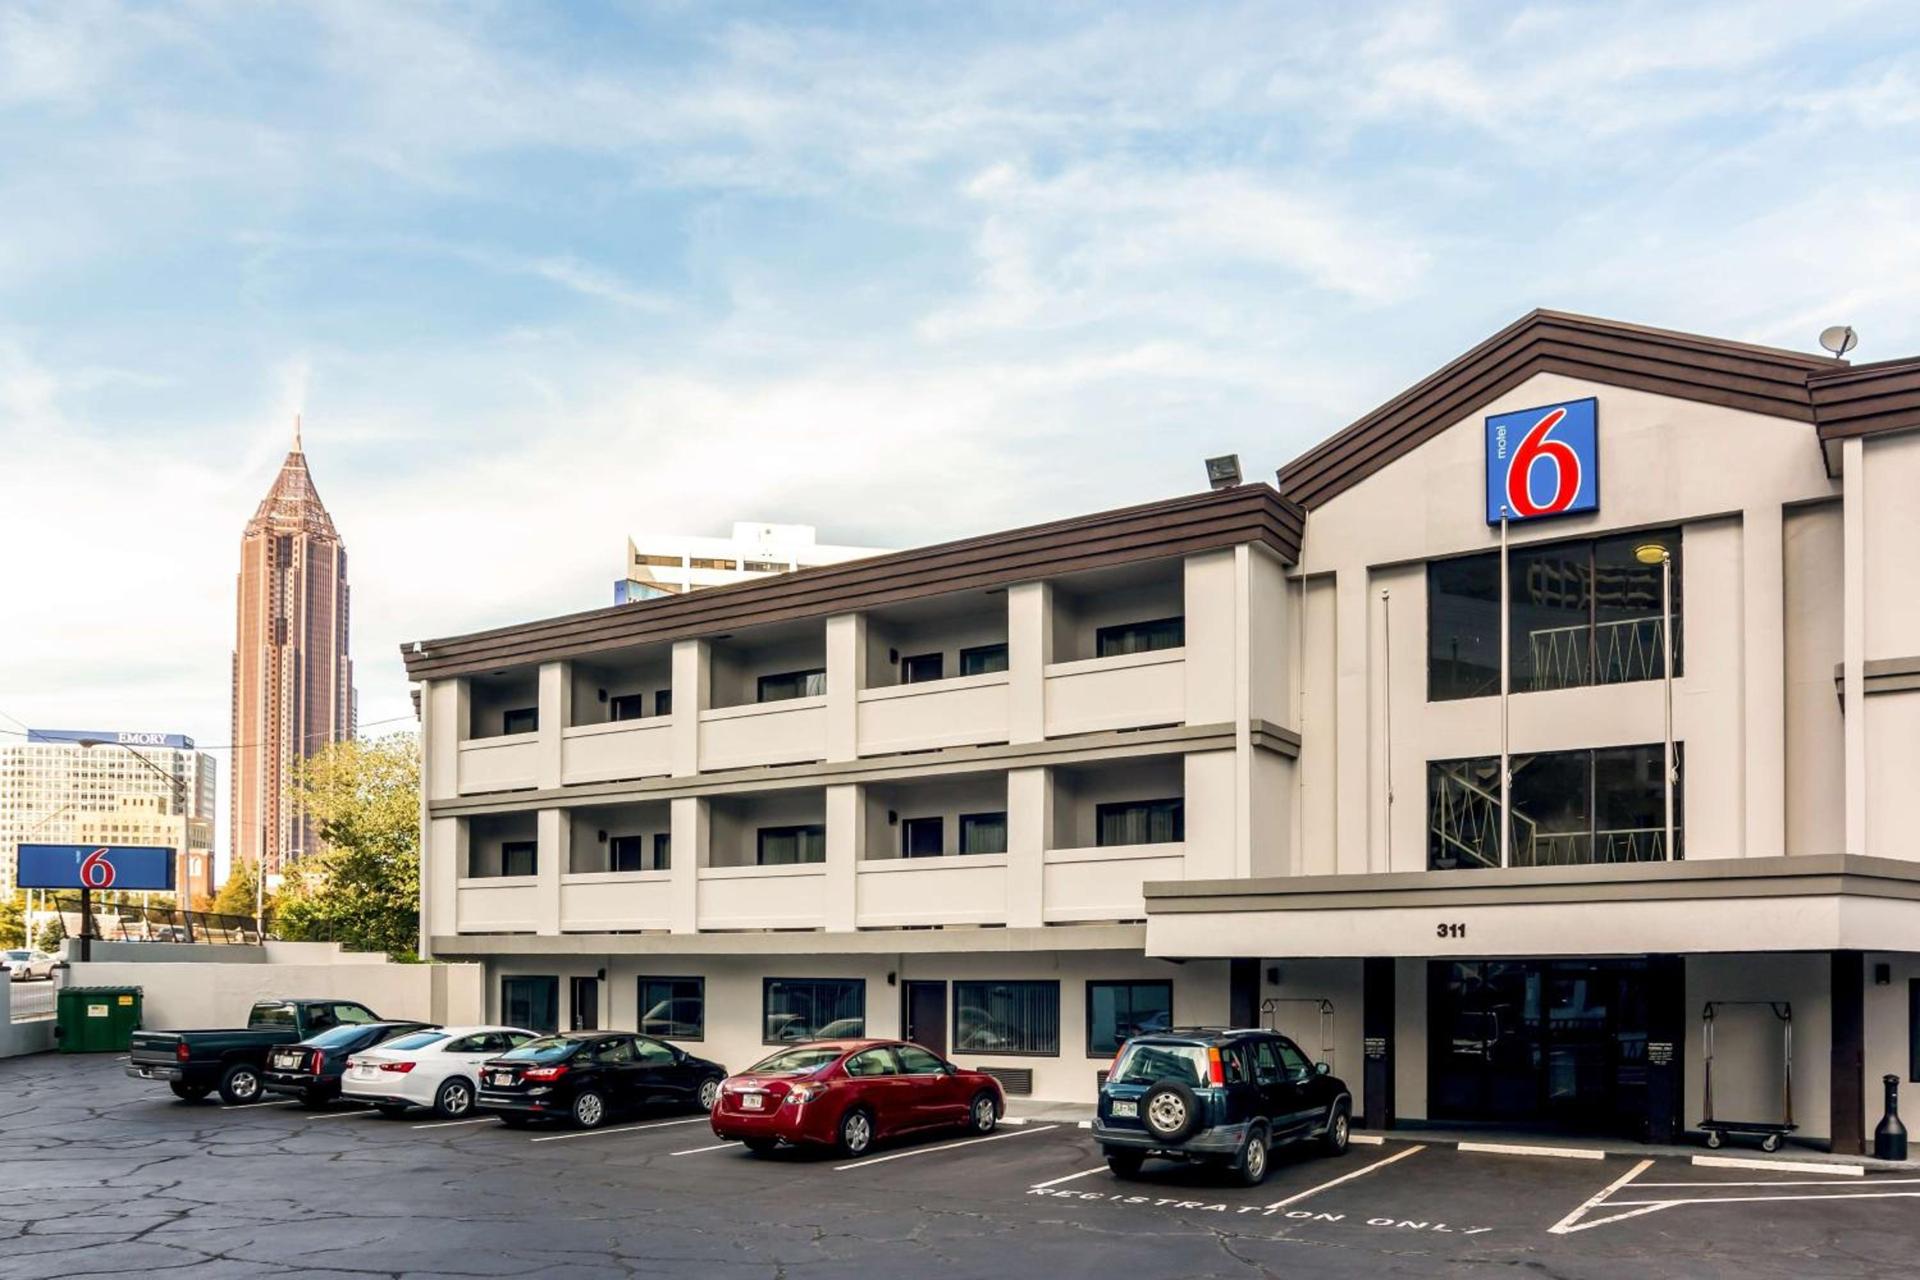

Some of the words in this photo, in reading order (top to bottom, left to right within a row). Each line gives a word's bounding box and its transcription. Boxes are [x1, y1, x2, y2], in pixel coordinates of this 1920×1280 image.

[1497, 425, 1507, 460] motel
[1506, 407, 1582, 517] 6
[118, 732, 167, 746] EMORY
[80, 847, 116, 888] 6
[1437, 923, 1466, 938] 311
[1026, 1187, 1346, 1222] REGISTRATION
[1366, 1217, 1493, 1235] ONLY
